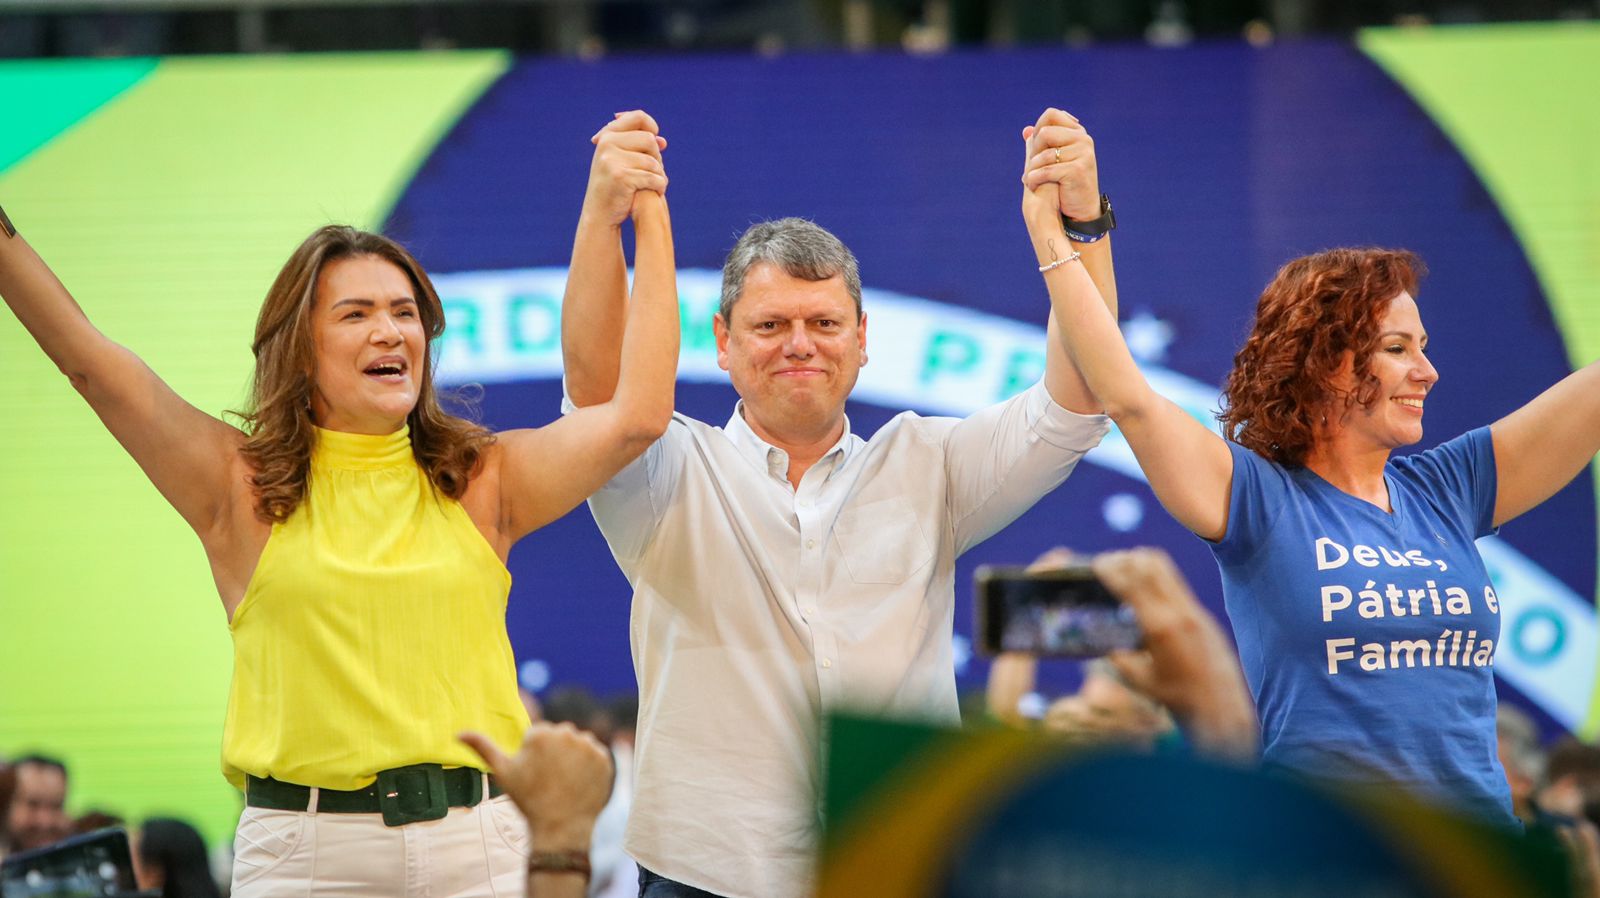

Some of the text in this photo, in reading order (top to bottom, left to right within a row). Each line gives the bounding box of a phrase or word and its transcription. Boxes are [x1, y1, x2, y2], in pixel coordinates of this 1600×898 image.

[1315, 536, 1448, 571] Deus,
[1320, 580, 1498, 622] Pátria e
